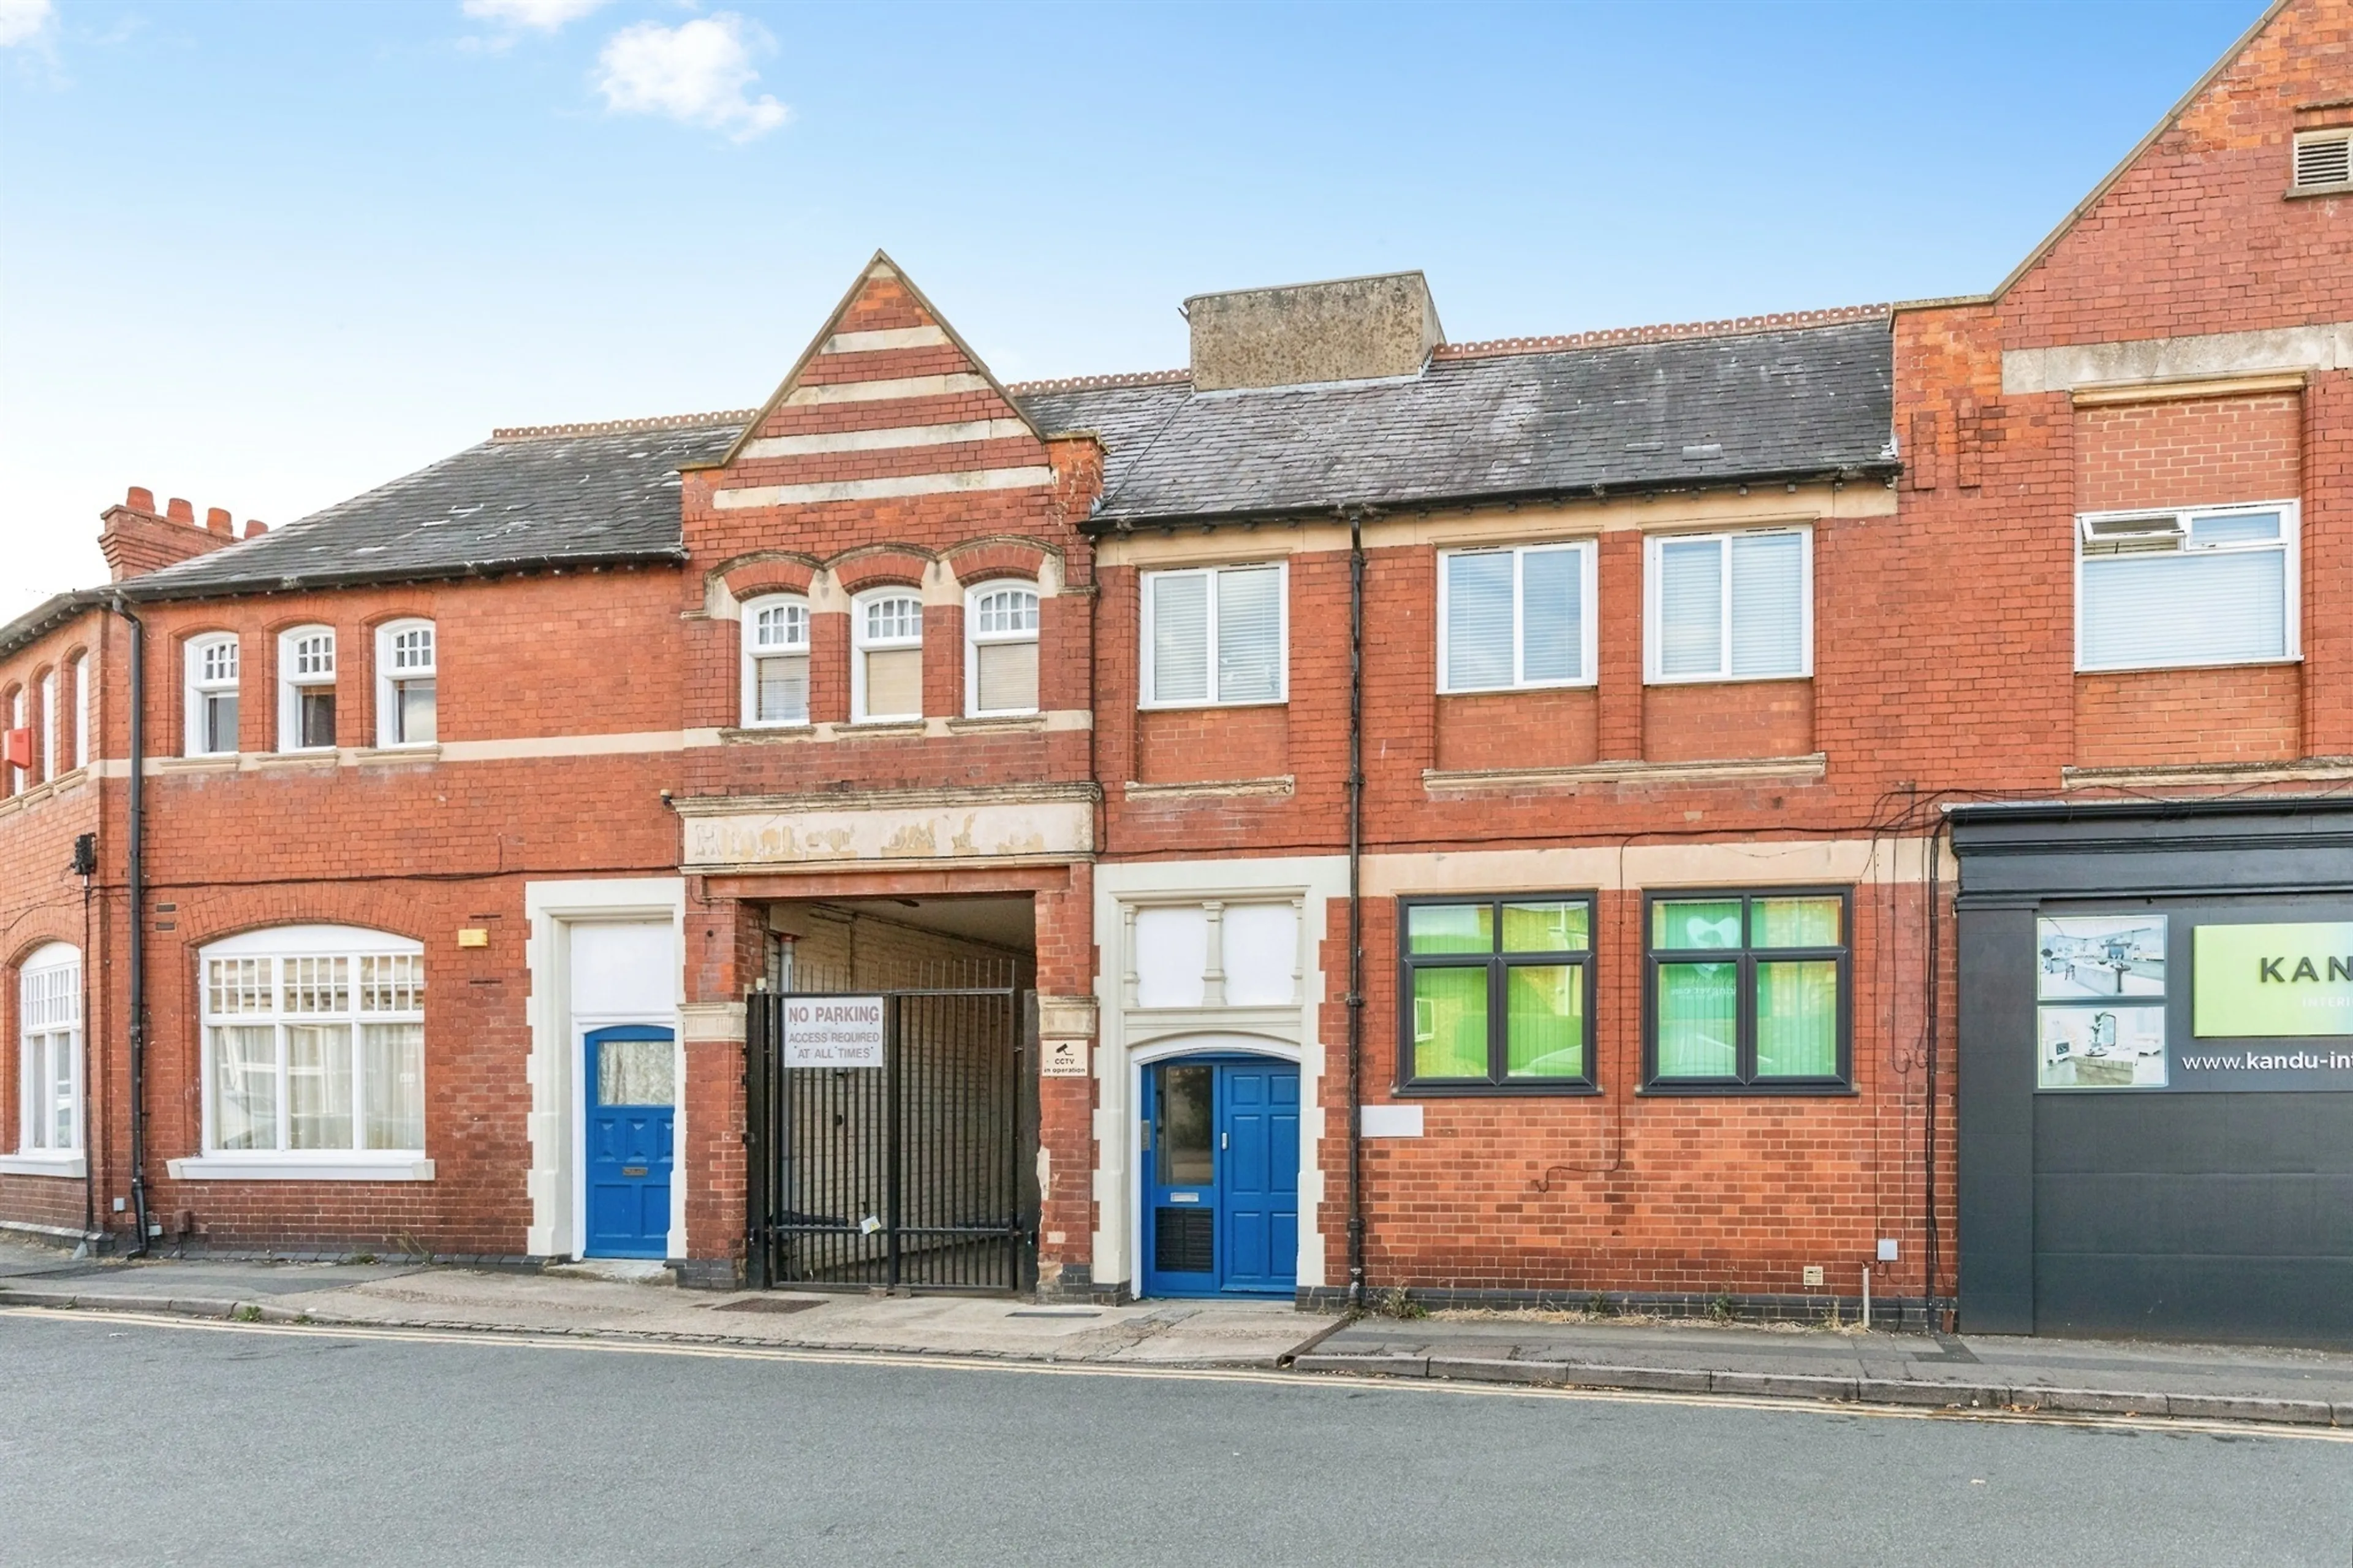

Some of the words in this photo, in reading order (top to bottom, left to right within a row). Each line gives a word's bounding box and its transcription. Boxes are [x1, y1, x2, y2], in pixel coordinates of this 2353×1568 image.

[2261, 956, 2353, 982] KAN
[2302, 996, 2353, 1007] INTERI
[789, 1007, 809, 1022] NO
[816, 1006, 879, 1022] PARKING
[789, 1033, 827, 1043] ACCESS
[832, 1032, 879, 1043] REQUIRED
[797, 1049, 810, 1058] AT
[814, 1049, 833, 1058] ALL
[838, 1048, 870, 1058] TIMES
